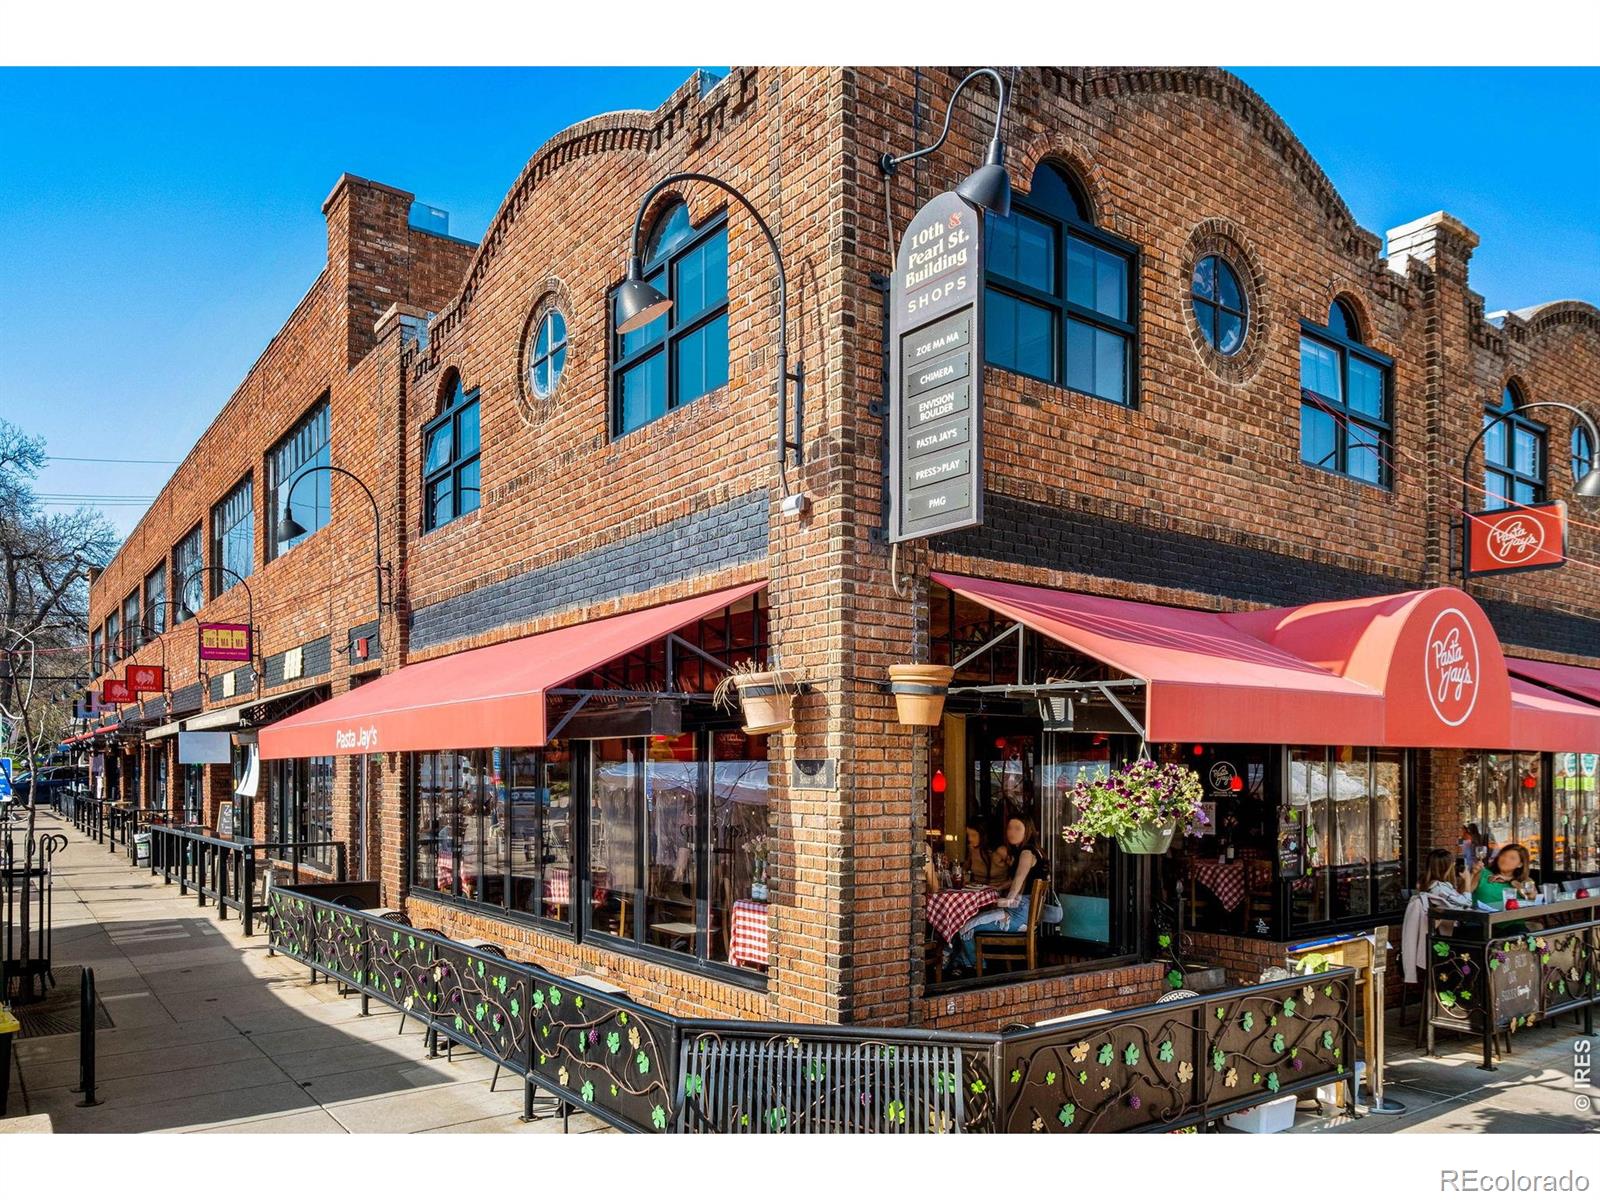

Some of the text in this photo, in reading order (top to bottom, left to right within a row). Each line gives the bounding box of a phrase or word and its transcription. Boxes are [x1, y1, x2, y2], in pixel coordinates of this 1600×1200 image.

[911, 211, 963, 250] 10th &
[908, 228, 970, 270] Pearl St.
[905, 247, 968, 289] Building
[907, 276, 967, 313] SHOPS
[916, 331, 960, 357] ZOE MA MA
[920, 365, 955, 385] CHIMERA
[919, 391, 955, 412] ENVISION
[919, 402, 954, 421] BOULDER
[916, 434, 938, 449] PASTA
[928, 496, 947, 508] PMG
[1493, 521, 1528, 546] Pasta
[1432, 627, 1464, 669] Pasta
[1438, 661, 1473, 703] Jay's
[335, 724, 378, 751] Pasta Jay's
